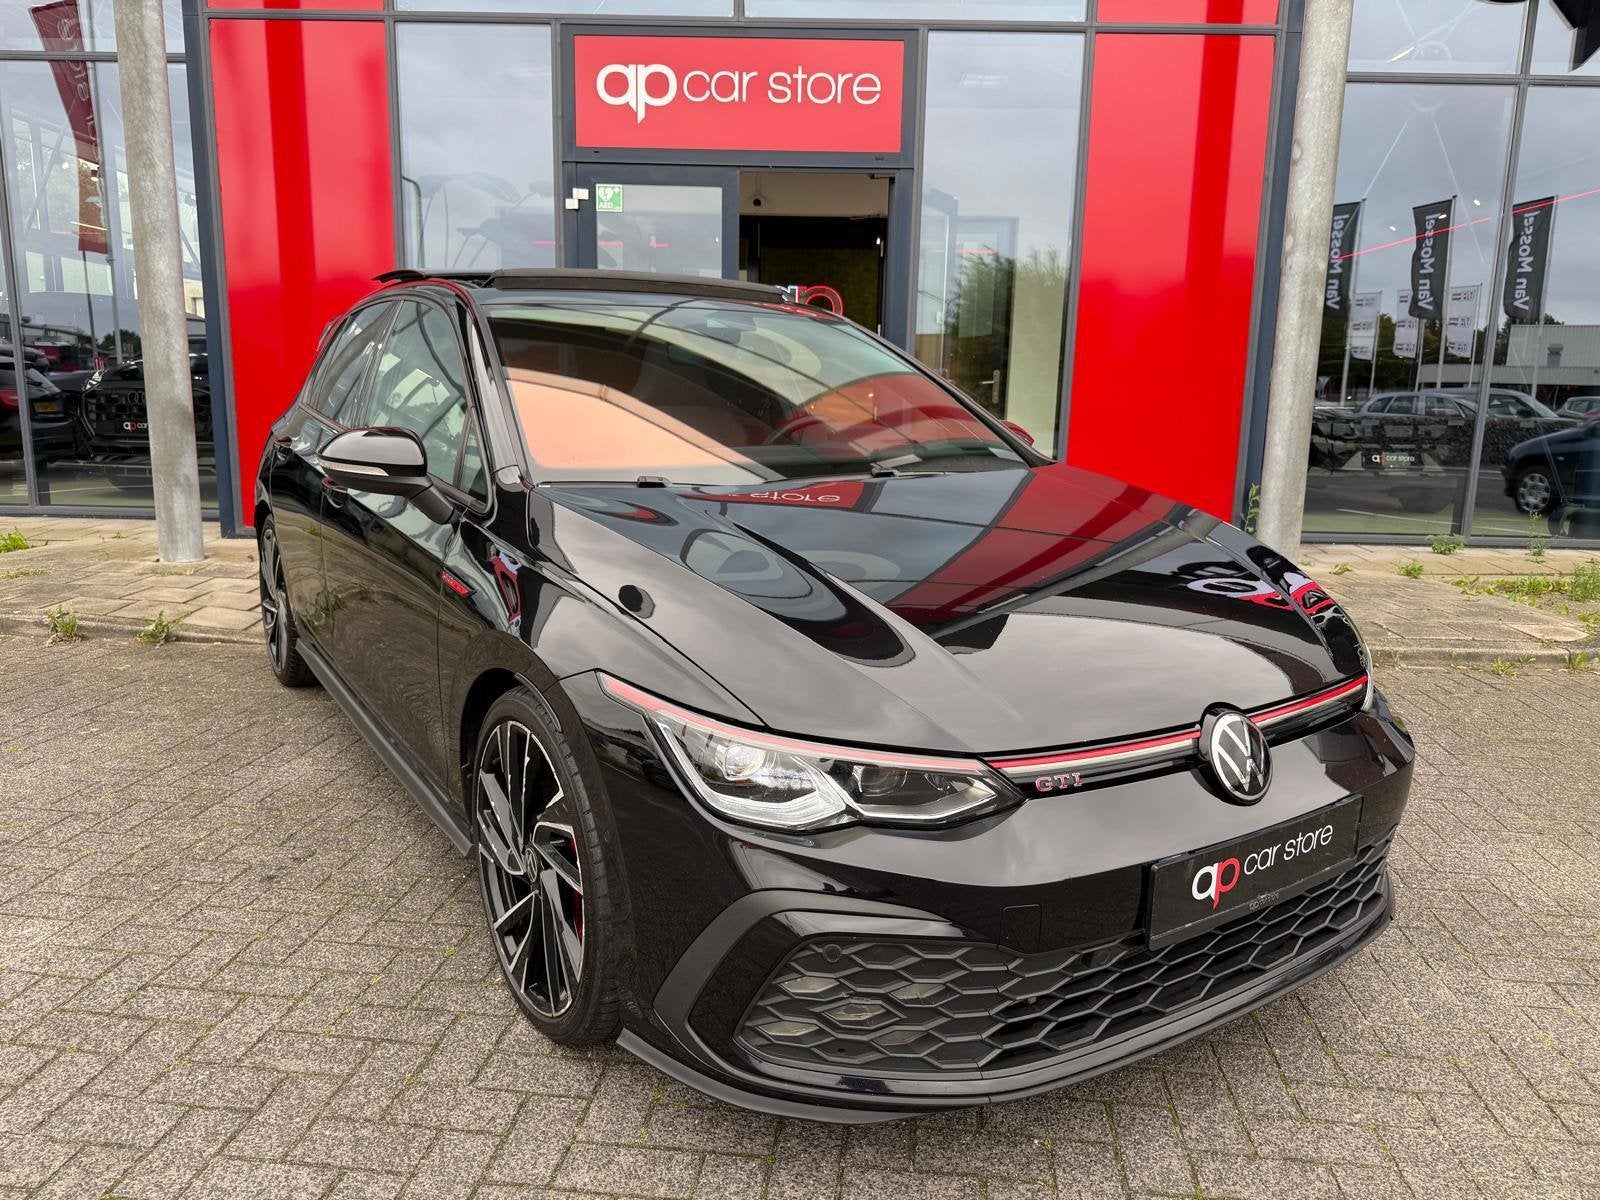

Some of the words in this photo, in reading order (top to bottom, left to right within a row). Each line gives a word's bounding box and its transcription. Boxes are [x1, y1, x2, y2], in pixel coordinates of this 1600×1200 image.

[596, 63, 678, 125] ap
[683, 70, 758, 103] car
[767, 65, 882, 105] store
[598, 201, 614, 210] AED
[1035, 771, 1084, 793] GTI
[1191, 857, 1241, 910] ap
[1243, 843, 1282, 875] car
[1284, 824, 1334, 861] store
